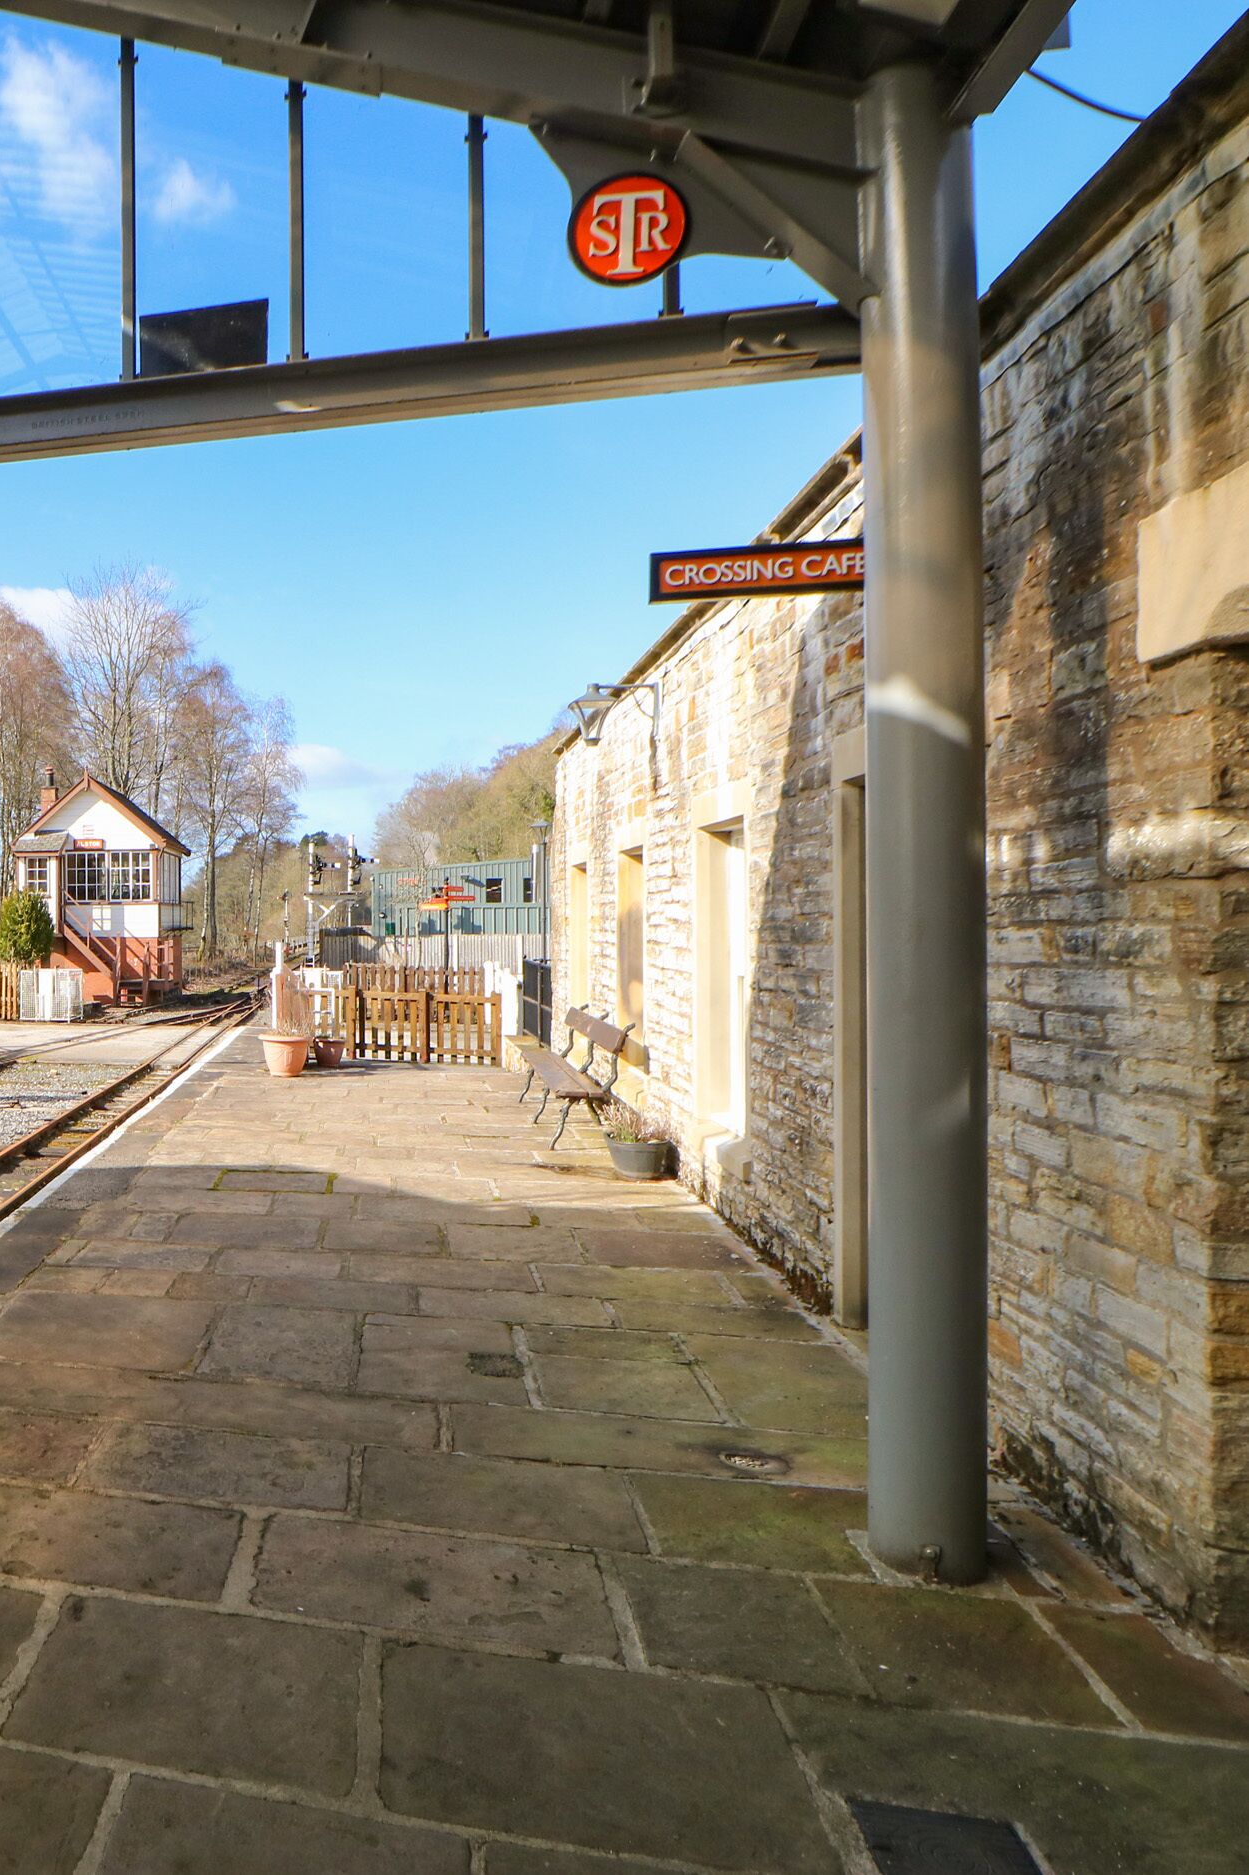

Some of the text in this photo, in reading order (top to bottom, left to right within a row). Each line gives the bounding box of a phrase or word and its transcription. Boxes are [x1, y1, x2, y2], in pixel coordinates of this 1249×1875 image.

[588, 188, 672, 276] STR
[664, 552, 865, 587] CROSSING CAFE
